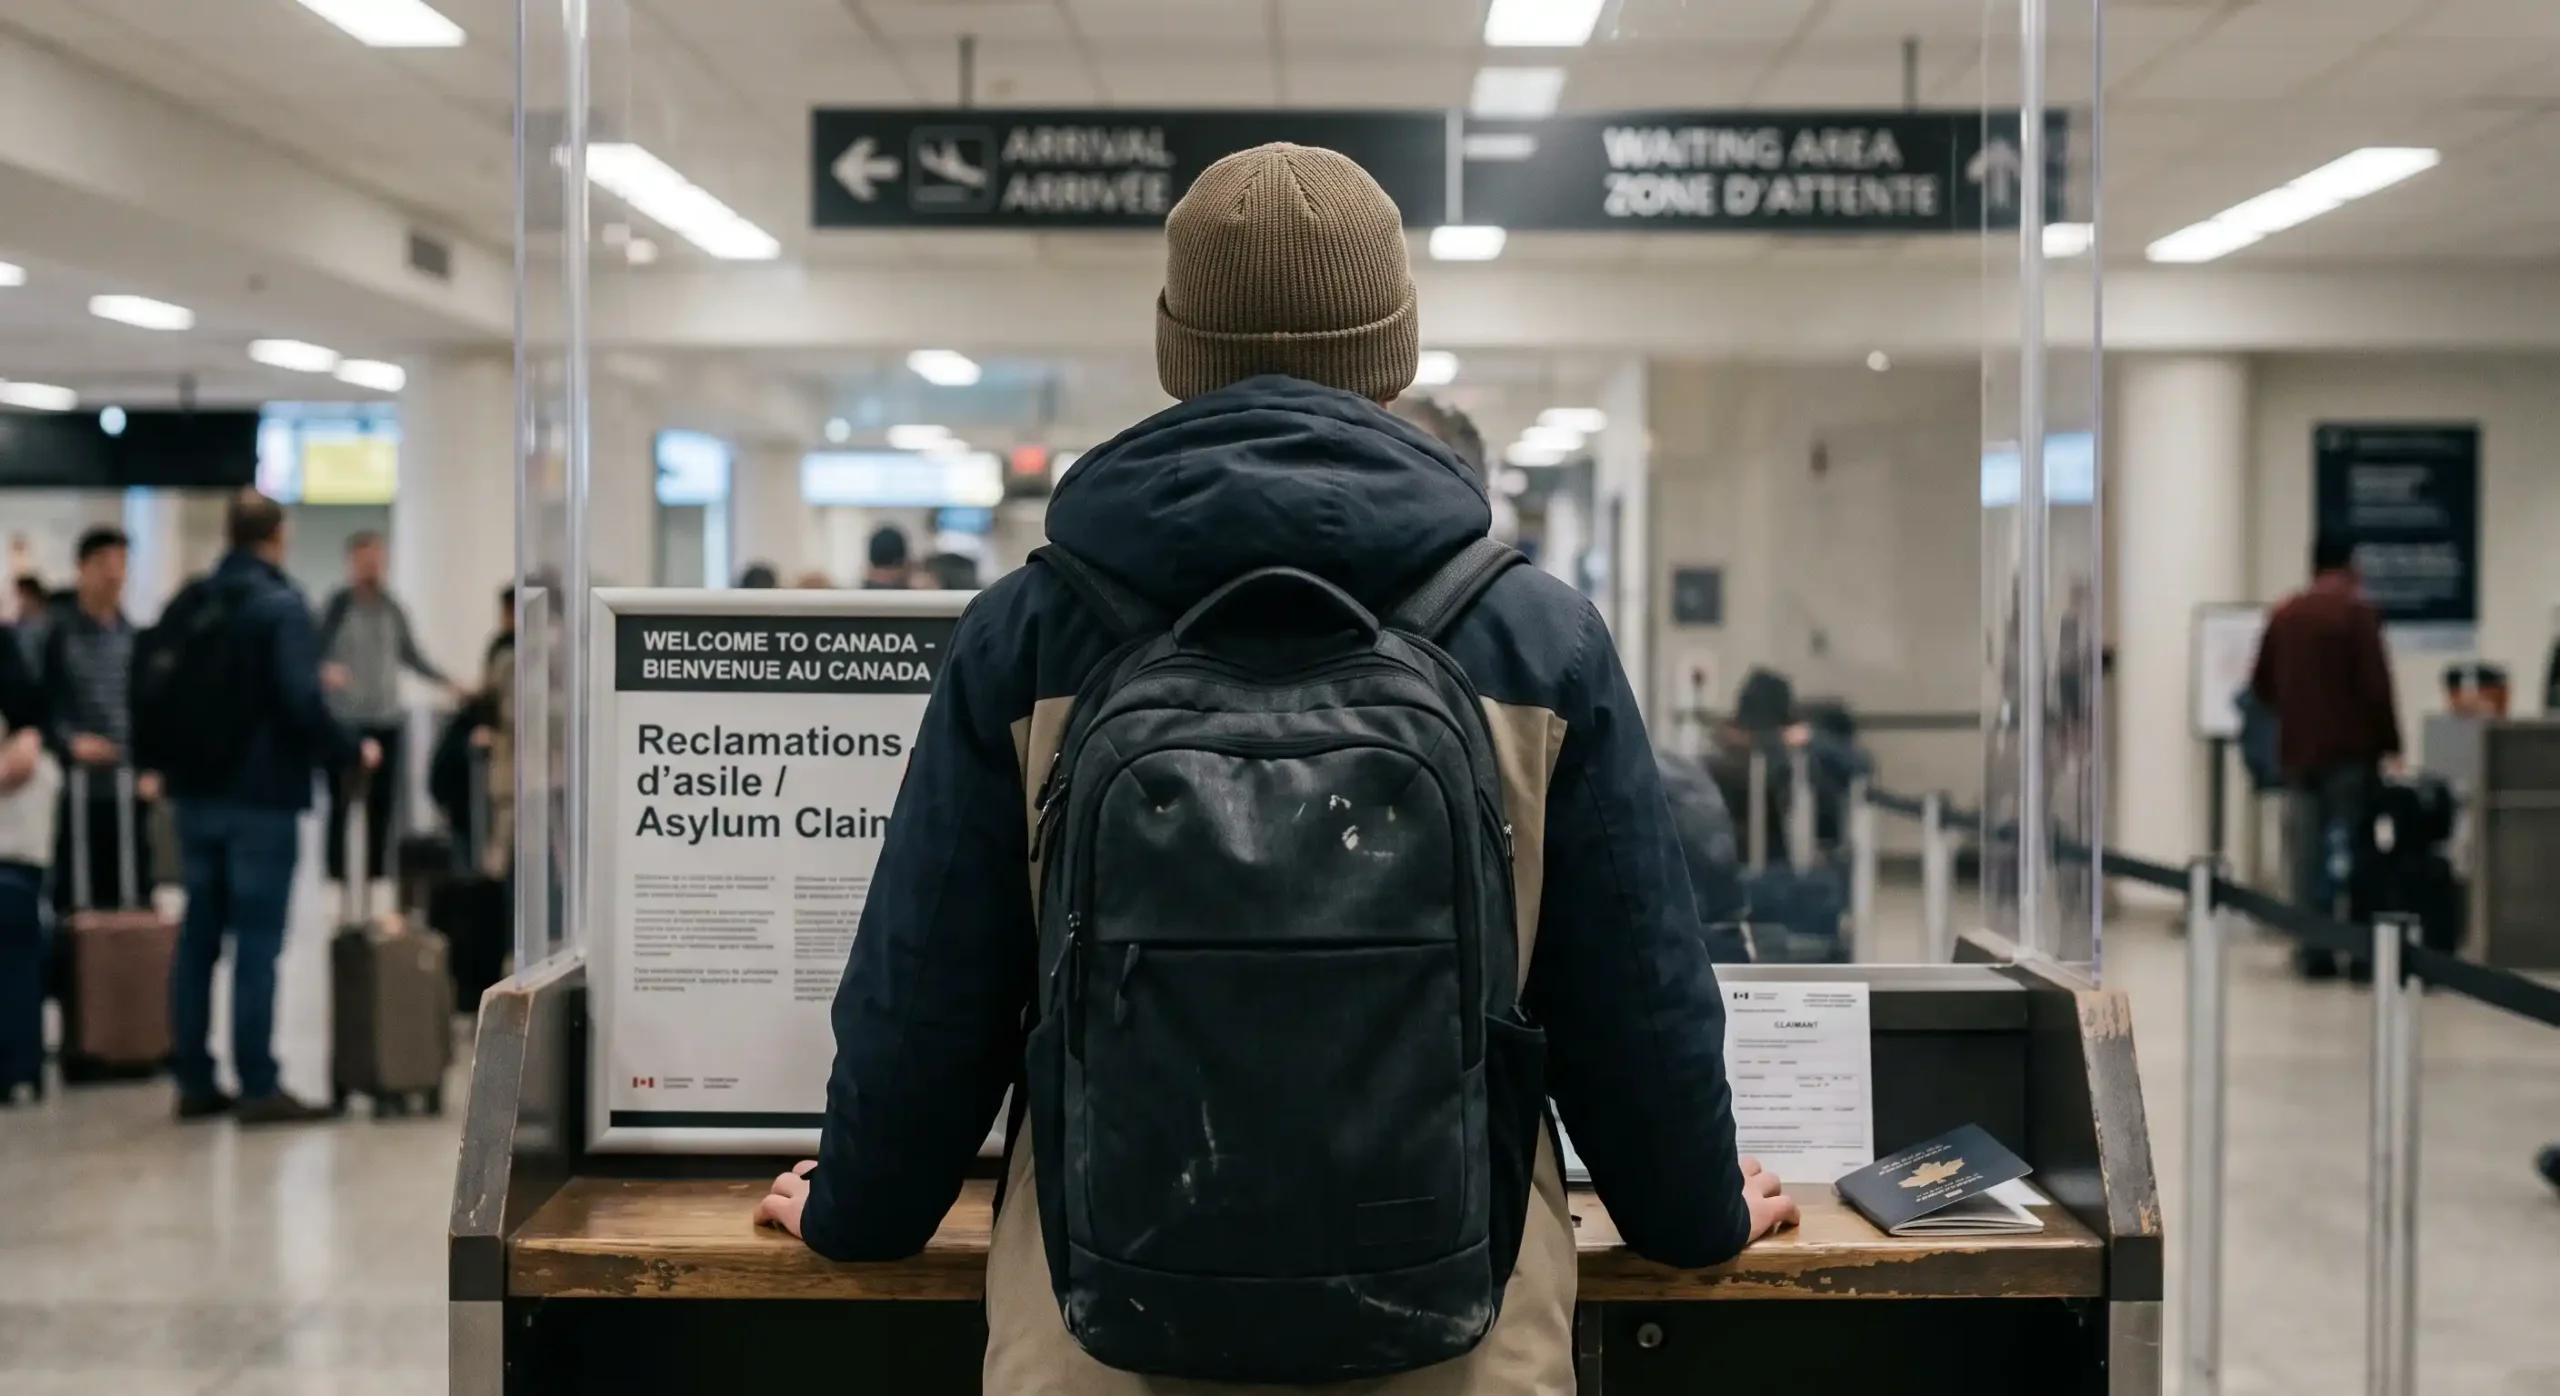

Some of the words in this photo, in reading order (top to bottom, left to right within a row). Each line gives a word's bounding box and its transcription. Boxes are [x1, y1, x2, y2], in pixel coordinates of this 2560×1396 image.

[1603, 127, 1784, 169] WAITING
[1788, 127, 1903, 168] AREA
[1603, 173, 1716, 216] ZONE
[1723, 174, 1938, 216] D'ATTENTE
[643, 630, 769, 652] WELCOME
[775, 631, 809, 652] TO
[815, 632, 918, 653] CANADA
[643, 658, 781, 680] BIENVENUE
[786, 660, 821, 681] AU
[828, 661, 931, 682] CANADA
[638, 724, 903, 757] Reclamations
[774, 765, 787, 797] /
[635, 805, 781, 845] Asylum
